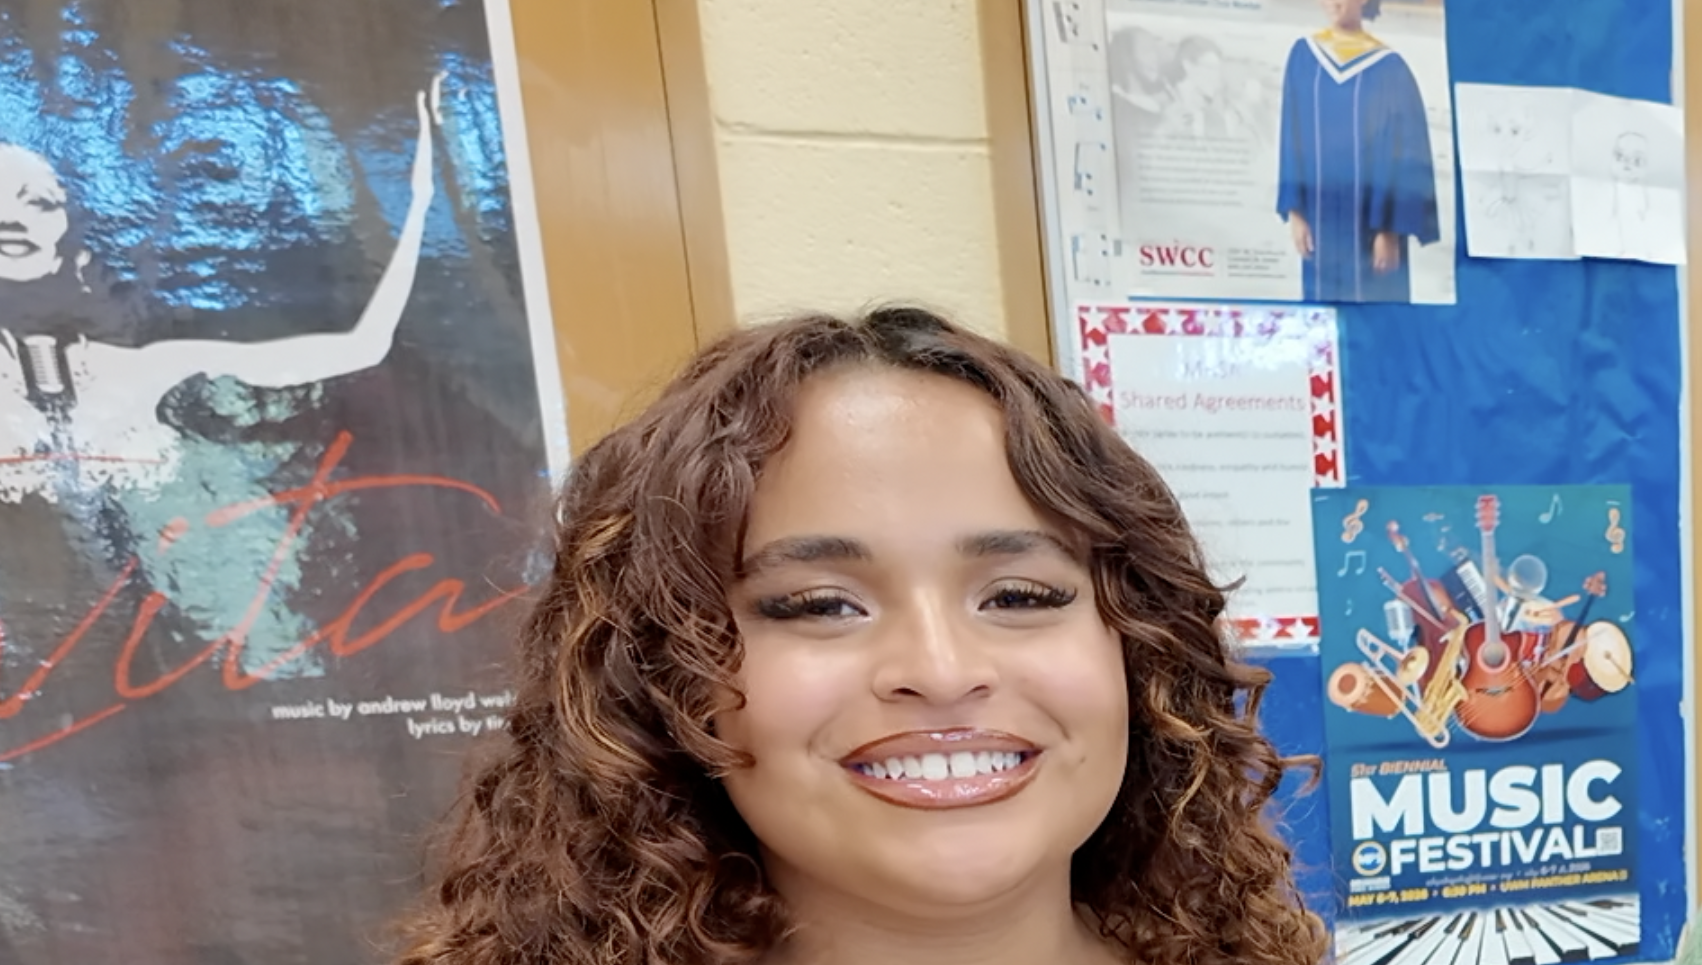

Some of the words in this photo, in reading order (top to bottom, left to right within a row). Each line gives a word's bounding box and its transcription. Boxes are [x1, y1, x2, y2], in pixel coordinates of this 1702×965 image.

[1139, 244, 1215, 268] SWCC
[1119, 390, 1187, 411] Shared
[1193, 392, 1307, 415] Agreements
[271, 700, 326, 720] music
[327, 697, 353, 721] by
[357, 695, 426, 716] andrew
[430, 692, 476, 714] lloyd
[406, 717, 455, 740] lyrics
[458, 714, 482, 737] by
[1350, 759, 1622, 840] MUSIC
[1390, 824, 1597, 876] FESTIVAL
